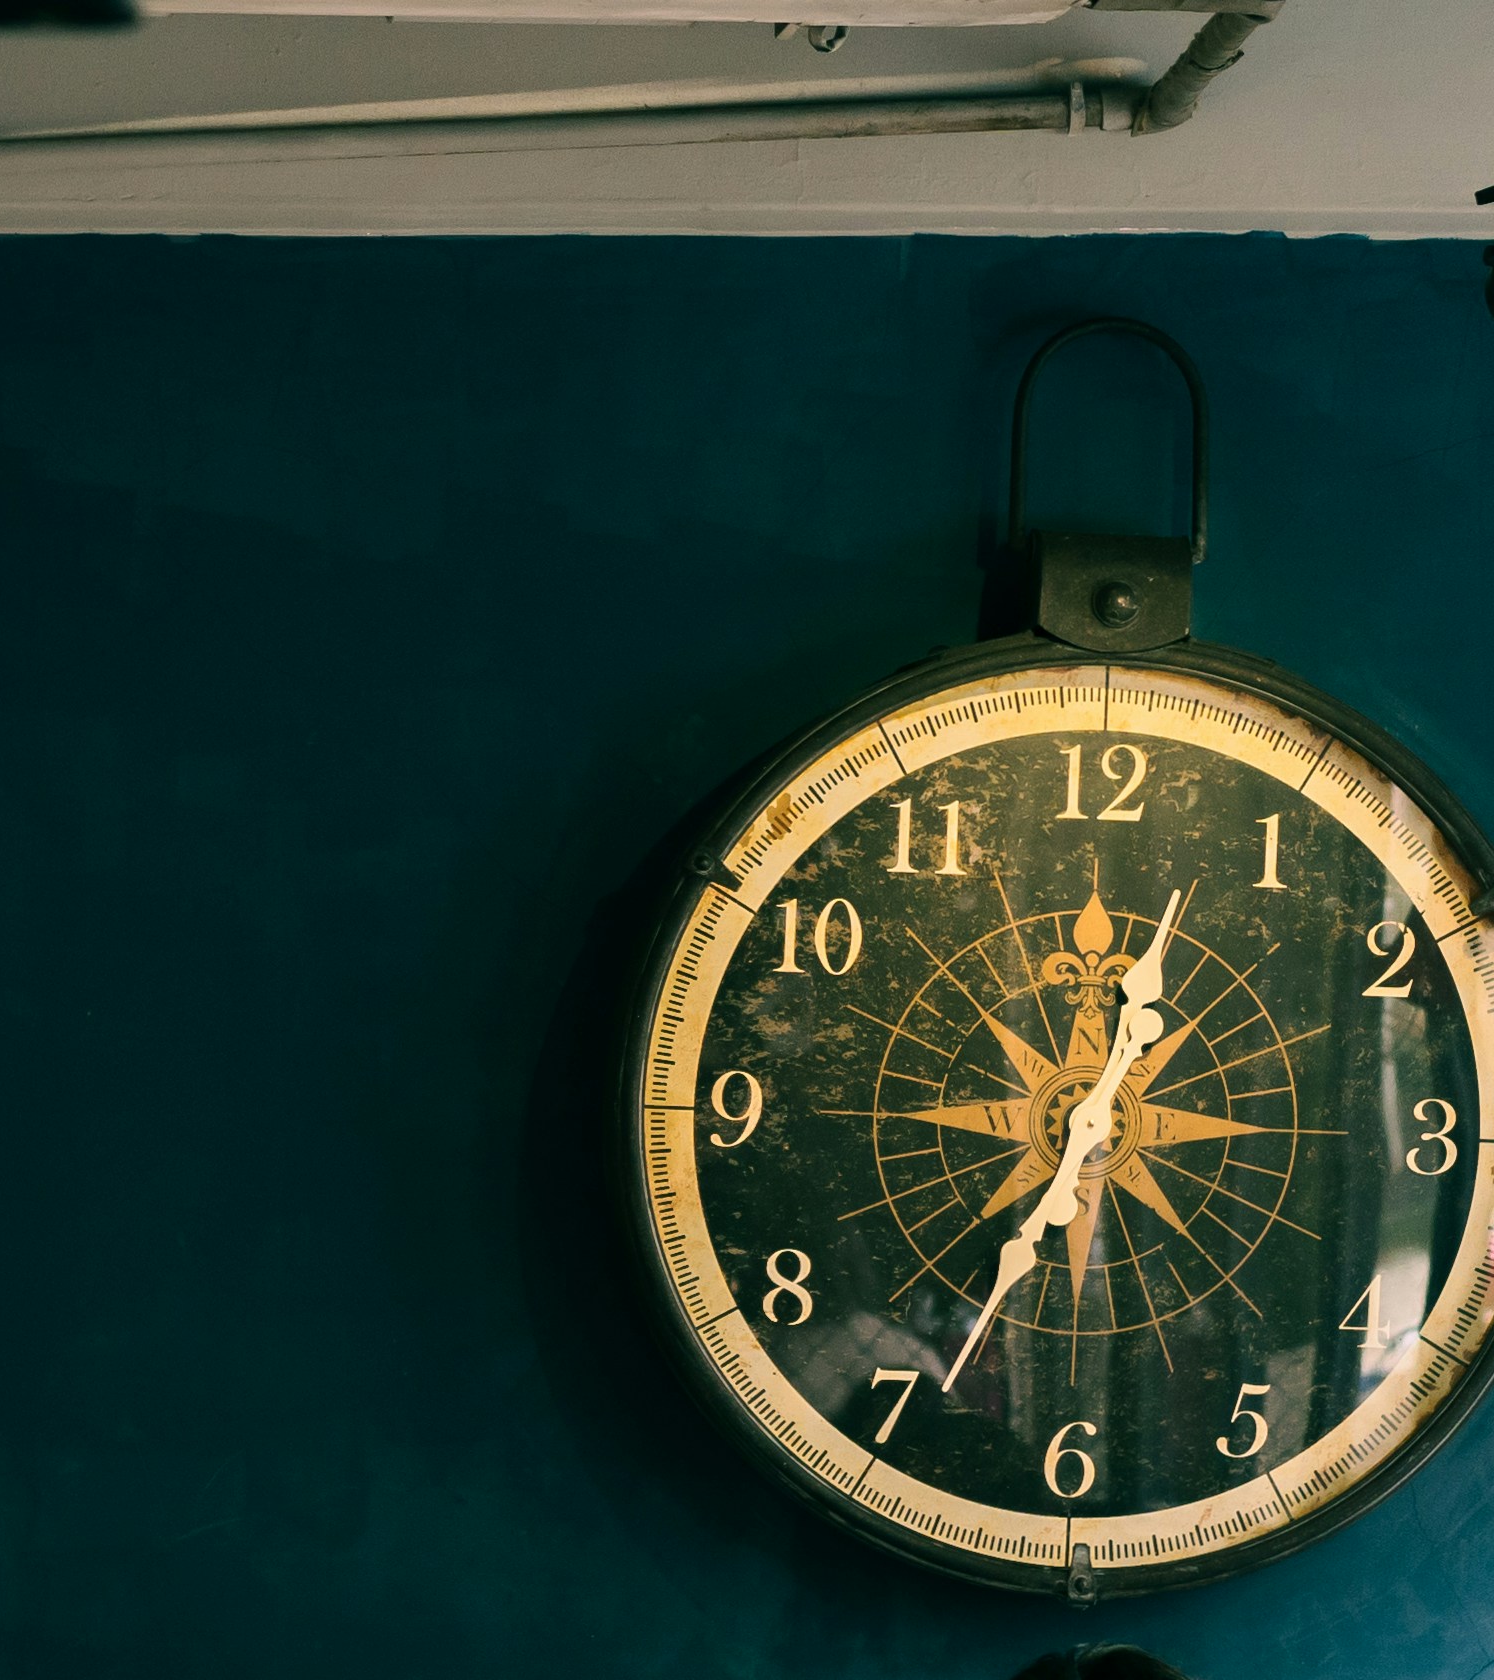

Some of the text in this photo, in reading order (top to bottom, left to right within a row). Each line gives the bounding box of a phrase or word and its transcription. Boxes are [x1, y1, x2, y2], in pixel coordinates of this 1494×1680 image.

[1053, 743, 1147, 822] 12
[886, 799, 969, 876] 11
[1252, 814, 1288, 889] 1
[772, 899, 863, 976] 10
[1362, 920, 1416, 1000] 2
[1017, 1049, 1052, 1079] NW
[1075, 1027, 1104, 1056] N
[710, 1071, 763, 1148] 9
[983, 1106, 1024, 1134] W
[1153, 1111, 1176, 1141] E
[1405, 1099, 1458, 1176] 3
[1072, 1186, 1091, 1217] S
[762, 1249, 813, 1326] 8
[1339, 1274, 1391, 1349] 4
[870, 1368, 918, 1443] 7
[1217, 1384, 1271, 1458] 5
[1044, 1421, 1097, 1498] 6
